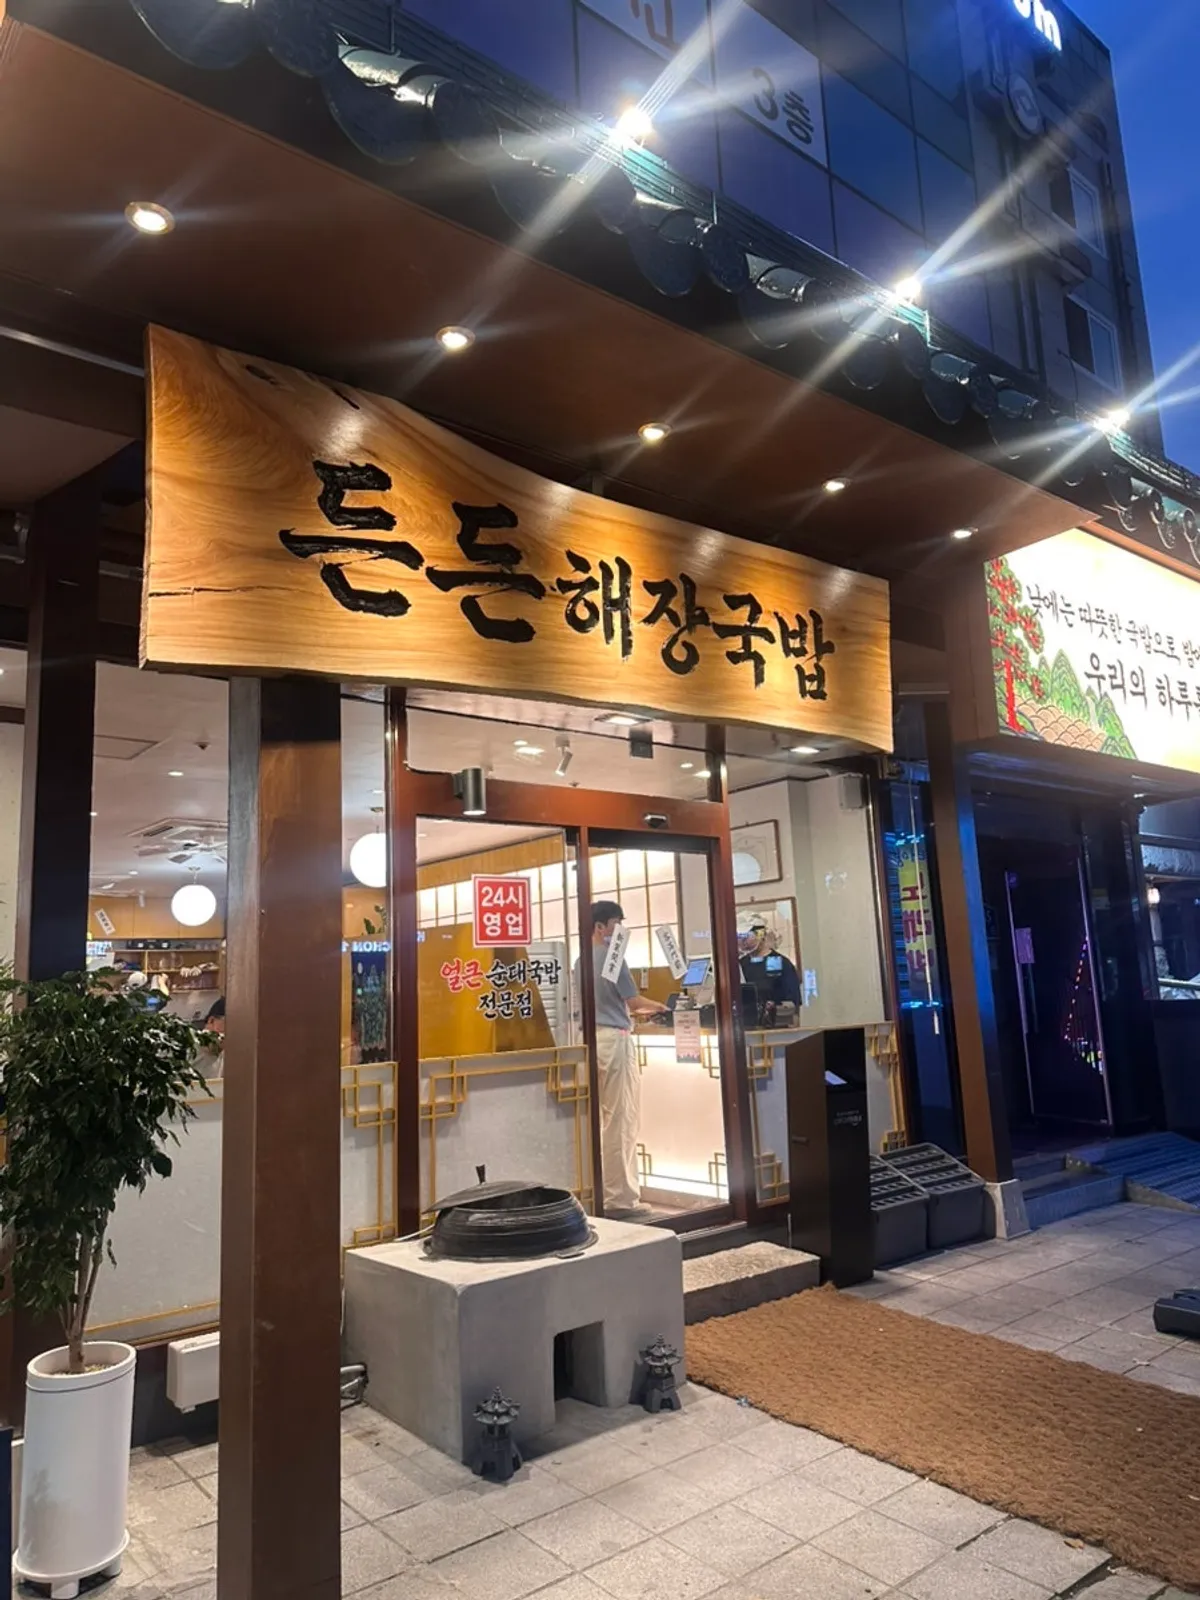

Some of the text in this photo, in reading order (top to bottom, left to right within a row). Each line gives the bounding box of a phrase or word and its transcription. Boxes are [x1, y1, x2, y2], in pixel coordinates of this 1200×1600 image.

[1026, 583, 1075, 628] 낮에는
[1078, 602, 1122, 645] 따뜻한
[1125, 619, 1181, 666] 국밥으로
[1084, 652, 1148, 711] 우리의
[481, 885, 523, 909] 24시
[483, 911, 523, 937] 영업
[440, 957, 562, 993] 얼큰 순대국밥
[477, 989, 534, 1020] 전문점
